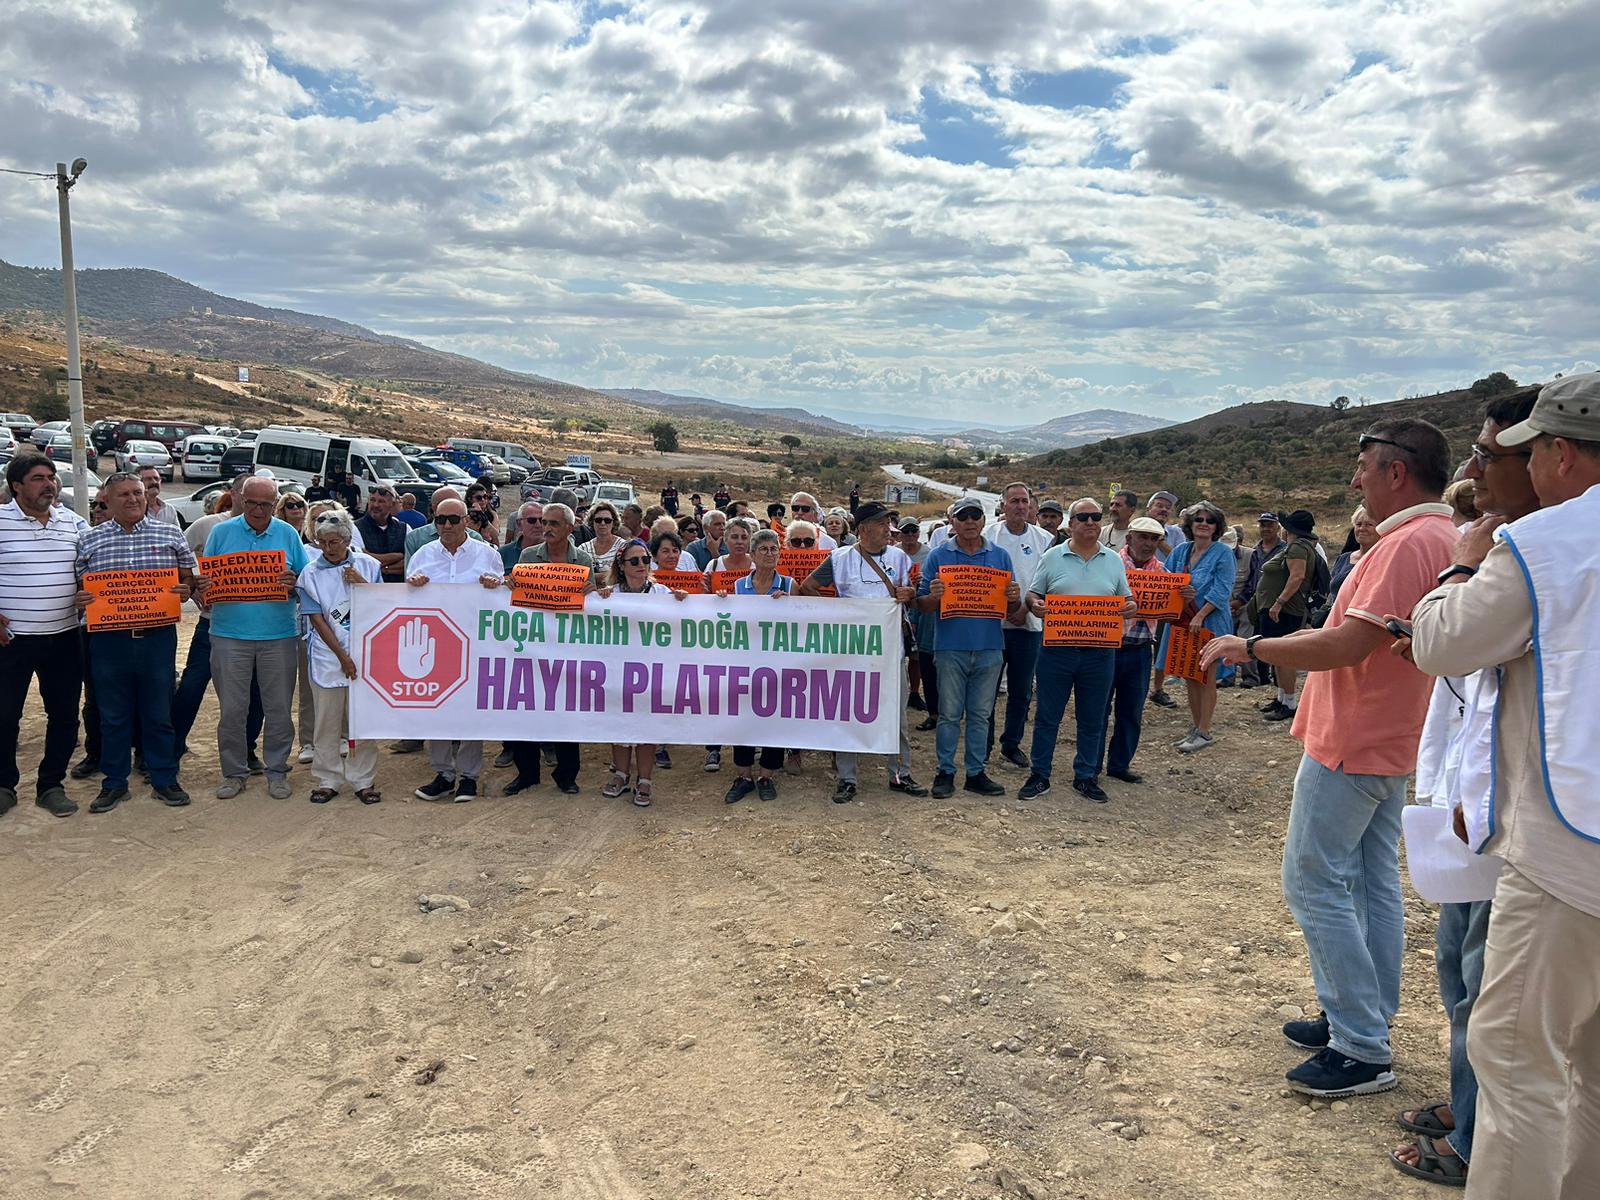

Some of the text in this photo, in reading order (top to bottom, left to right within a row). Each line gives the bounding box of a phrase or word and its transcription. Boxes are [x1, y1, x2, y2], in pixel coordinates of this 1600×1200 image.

[201, 552, 282, 570] BELEDİYEYİ
[800, 552, 830, 560] HAFRİYA
[546, 566, 585, 574] HAFRİYAT
[972, 567, 1008, 578] YANGINI
[86, 570, 174, 581] ORMAN YANGINI
[514, 571, 585, 582] ALANI KAPATILSIN
[1126, 574, 1184, 583] AÇAK HAFRİYAT
[99, 587, 164, 597] SORUMSUZLUK
[206, 587, 240, 597] ORMANI
[241, 585, 285, 594] KORUYUN!
[514, 581, 583, 594] ORMANLARIMIZ
[108, 595, 158, 604] CEZASIZLIK
[524, 592, 571, 603] YANMASIN!
[1135, 590, 1170, 600] YETER
[117, 604, 149, 612] İMARLA
[1080, 599, 1120, 607] HAFRİYAT
[100, 611, 168, 622] ÖDÜLLENDİRME
[1046, 620, 1119, 629] ORMANLARIMIZ
[478, 609, 883, 656] FOÇA TARİH ve DOĞA TALANINA
[1056, 630, 1107, 638] YANMASIN!
[391, 681, 440, 697] STOP
[476, 657, 881, 724] HAYIR PLATFORMU
